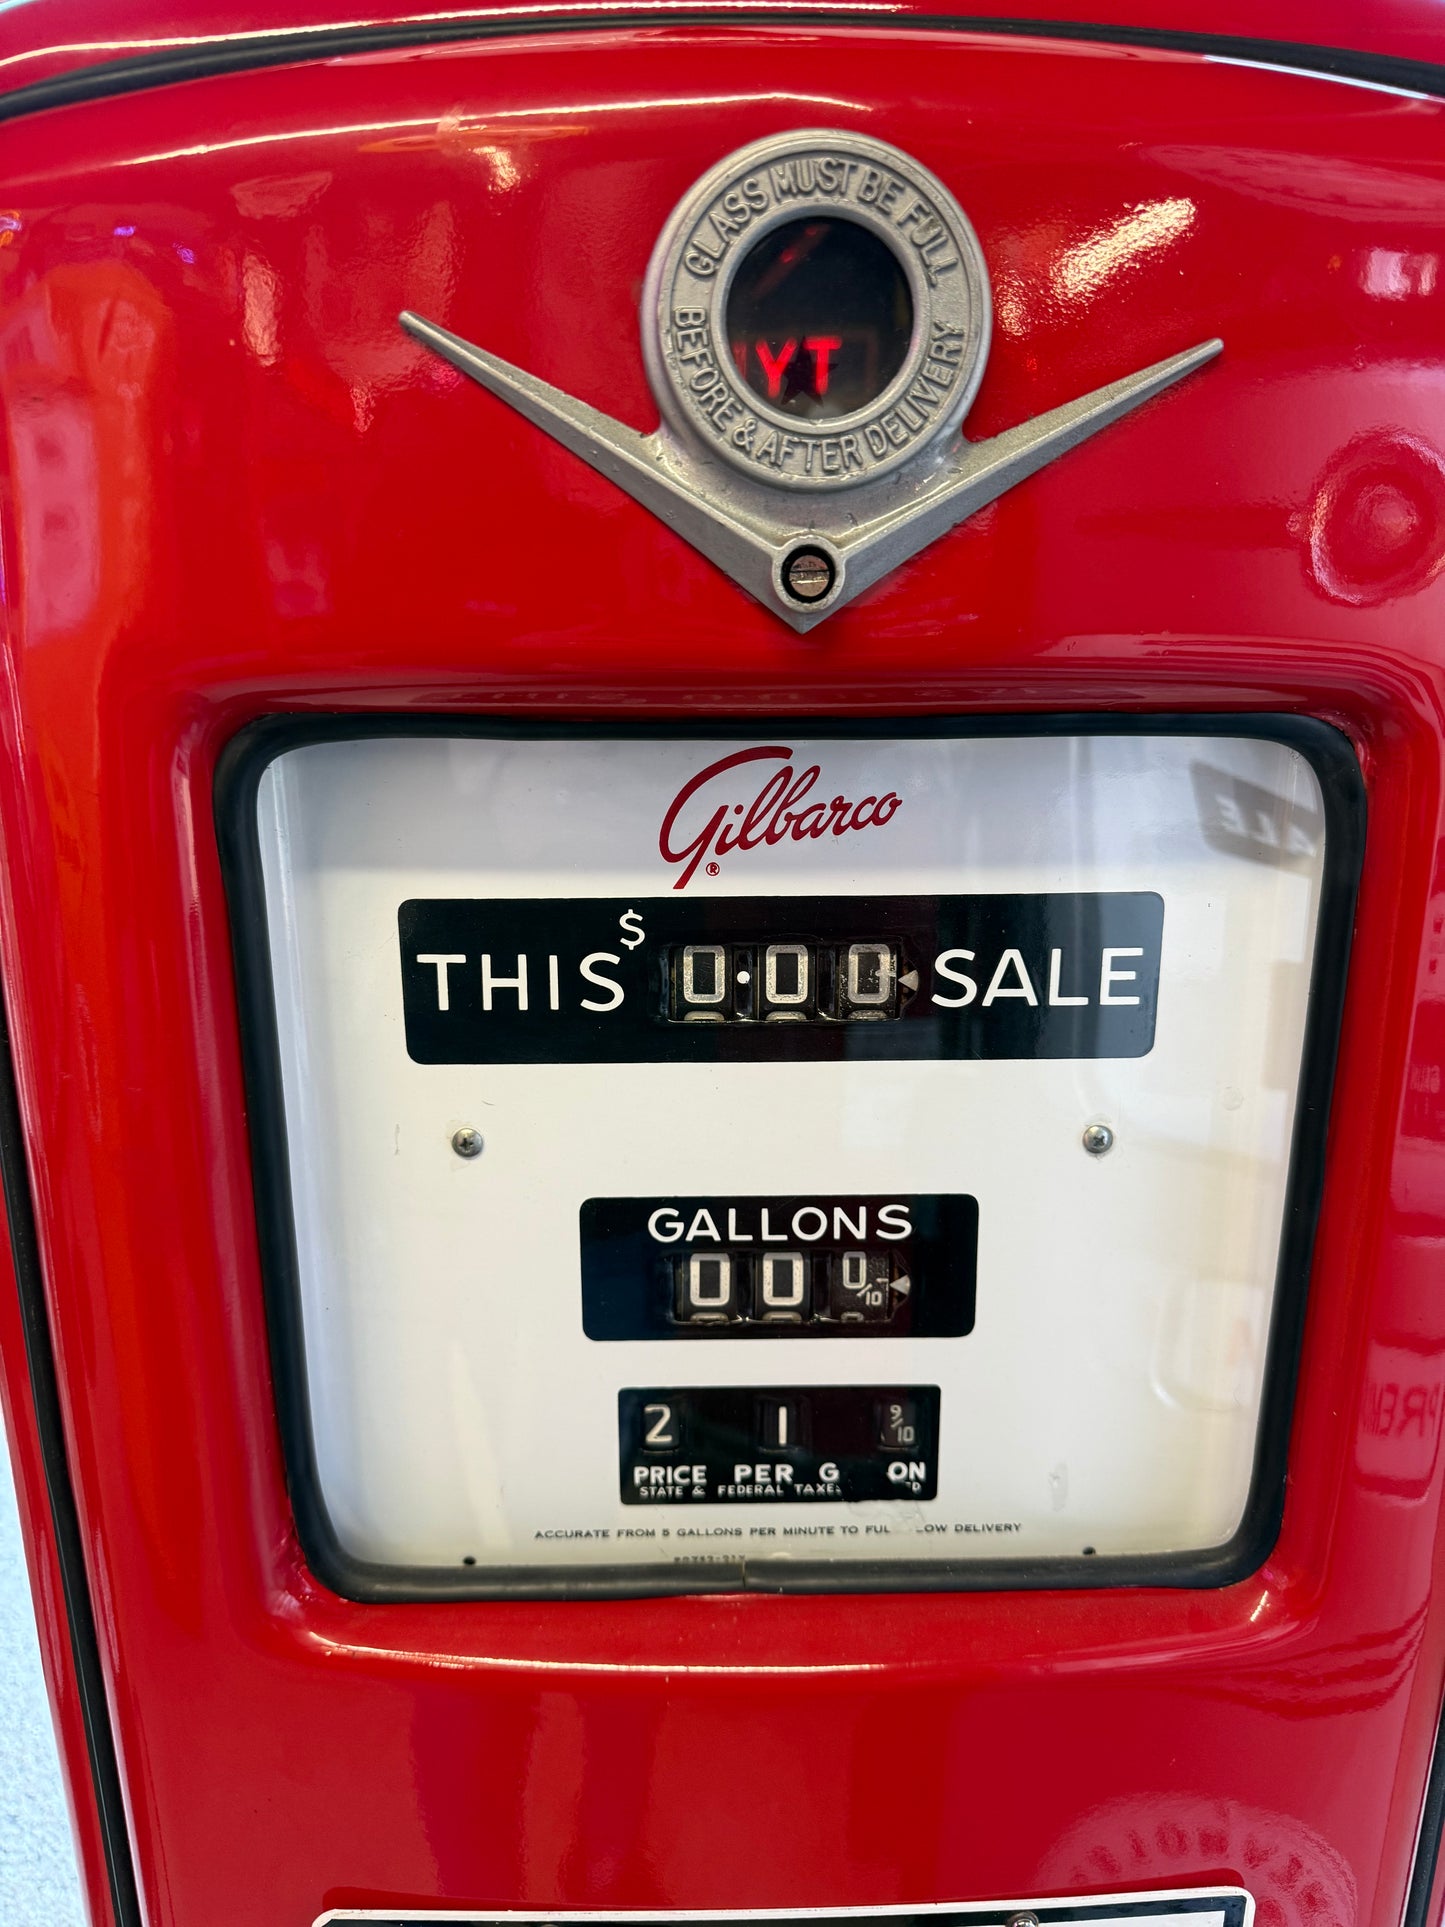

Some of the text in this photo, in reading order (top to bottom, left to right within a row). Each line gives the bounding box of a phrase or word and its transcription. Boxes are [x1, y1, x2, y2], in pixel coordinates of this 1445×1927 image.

[684, 157, 959, 288] GLASS MUST BE FULL
[672, 306, 965, 473] BEFORE & AFTER DELIVERY
[659, 745, 903, 890] Gilbarco
[416, 951, 625, 1012] THIS
[618, 908, 646, 951] $
[931, 947, 1144, 1008] SALE
[647, 1204, 913, 1243] GALLONS
[644, 1403, 673, 1443] 2
[633, 1465, 708, 1485] PRICE
[734, 1463, 794, 1484] PER
[640, 1486, 684, 1497] STATE
[692, 1485, 706, 1497] &
[718, 1484, 784, 1495] FEDERAL
[534, 1529, 610, 1539] ACCURATE
[617, 1528, 656, 1538] FROM
[661, 1528, 670, 1537] 5
[676, 1527, 743, 1537] GALLONS
[750, 1526, 777, 1536] PER
[783, 1525, 835, 1536] MINUTE
[840, 1525, 858, 1535] TO
[865, 1524, 891, 1534] FUL
[954, 1522, 1022, 1533] DELIVERY
